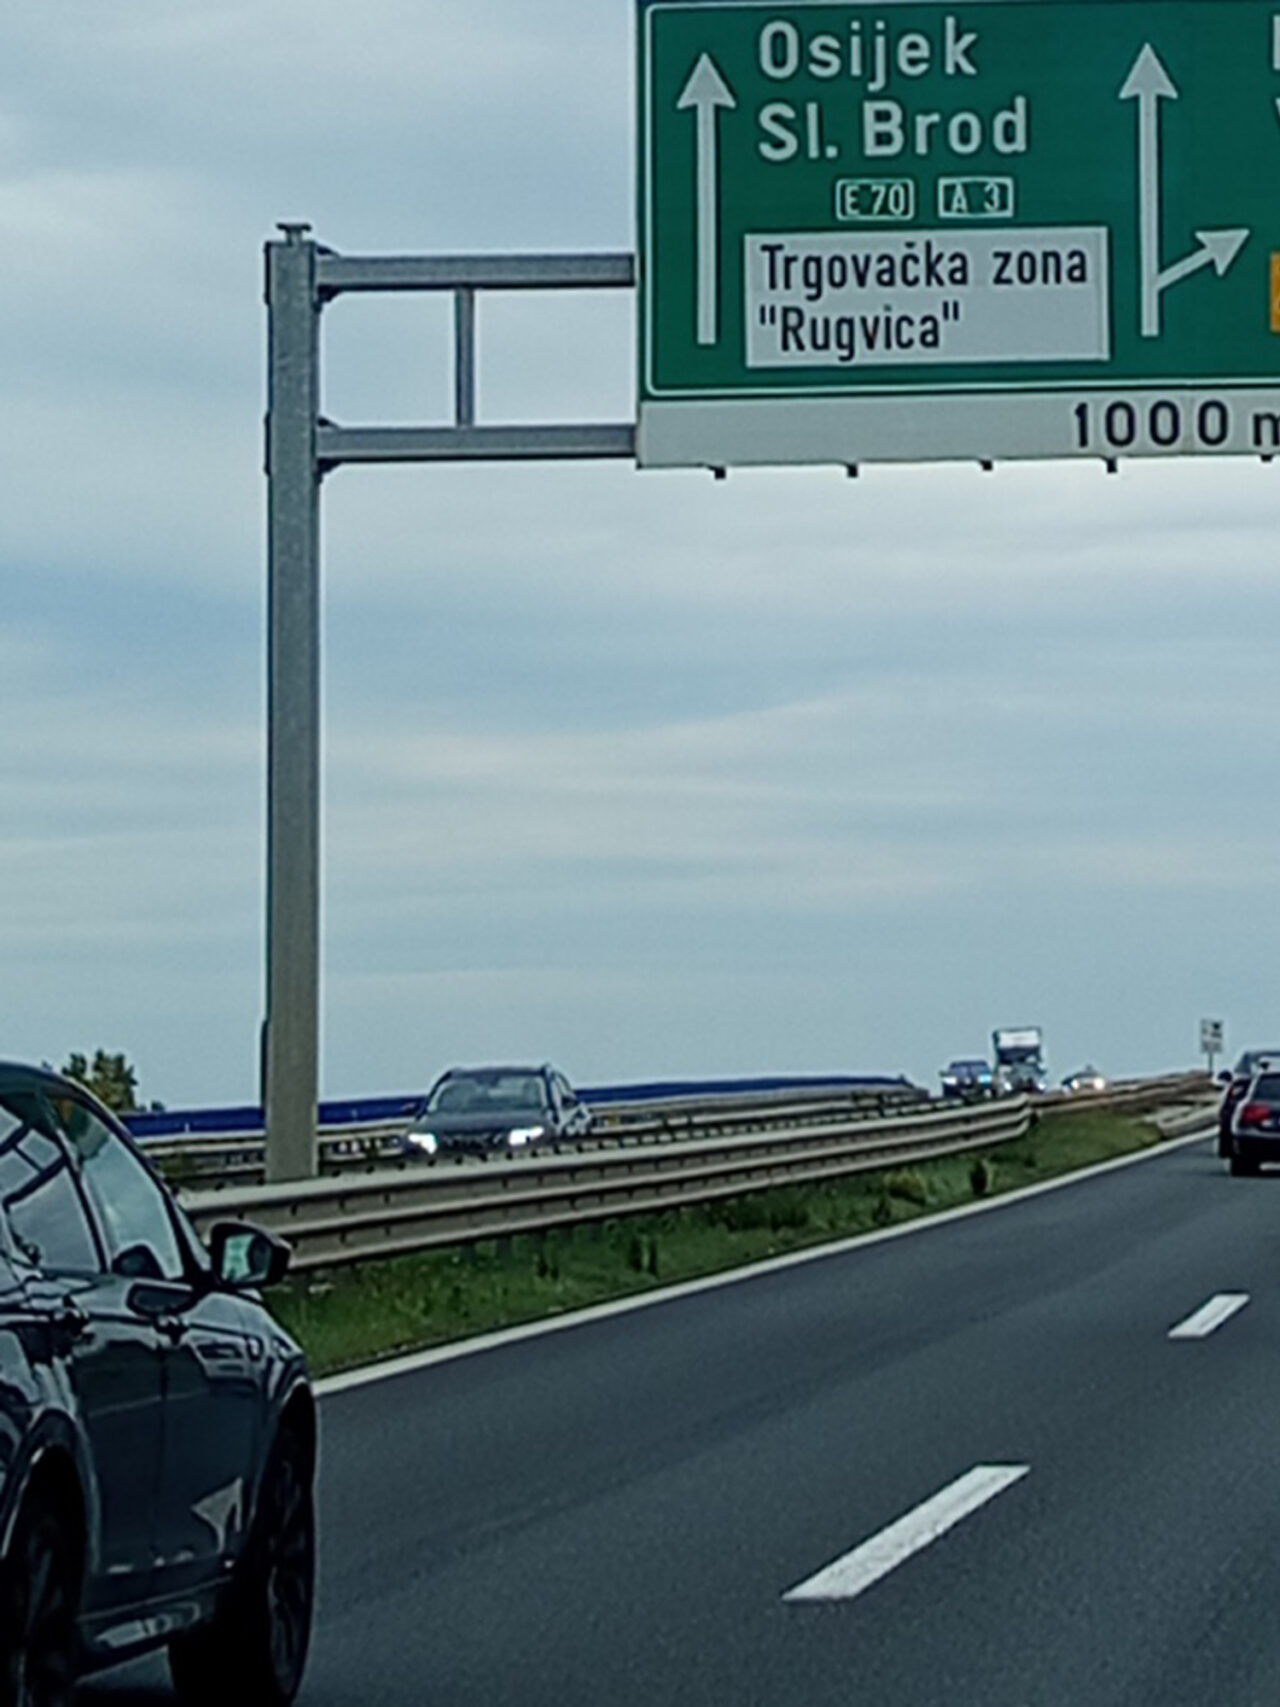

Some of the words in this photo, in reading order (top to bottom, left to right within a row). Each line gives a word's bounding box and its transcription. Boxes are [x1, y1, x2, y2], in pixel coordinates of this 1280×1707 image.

[761, 17, 976, 91] Osijek
[760, 103, 837, 160] Sl.
[864, 96, 1027, 156] Brod
[761, 240, 968, 302] Trgovačka
[993, 250, 1087, 284] zona
[760, 301, 959, 361] "Rugvica"
[1074, 400, 1229, 447] 1000
